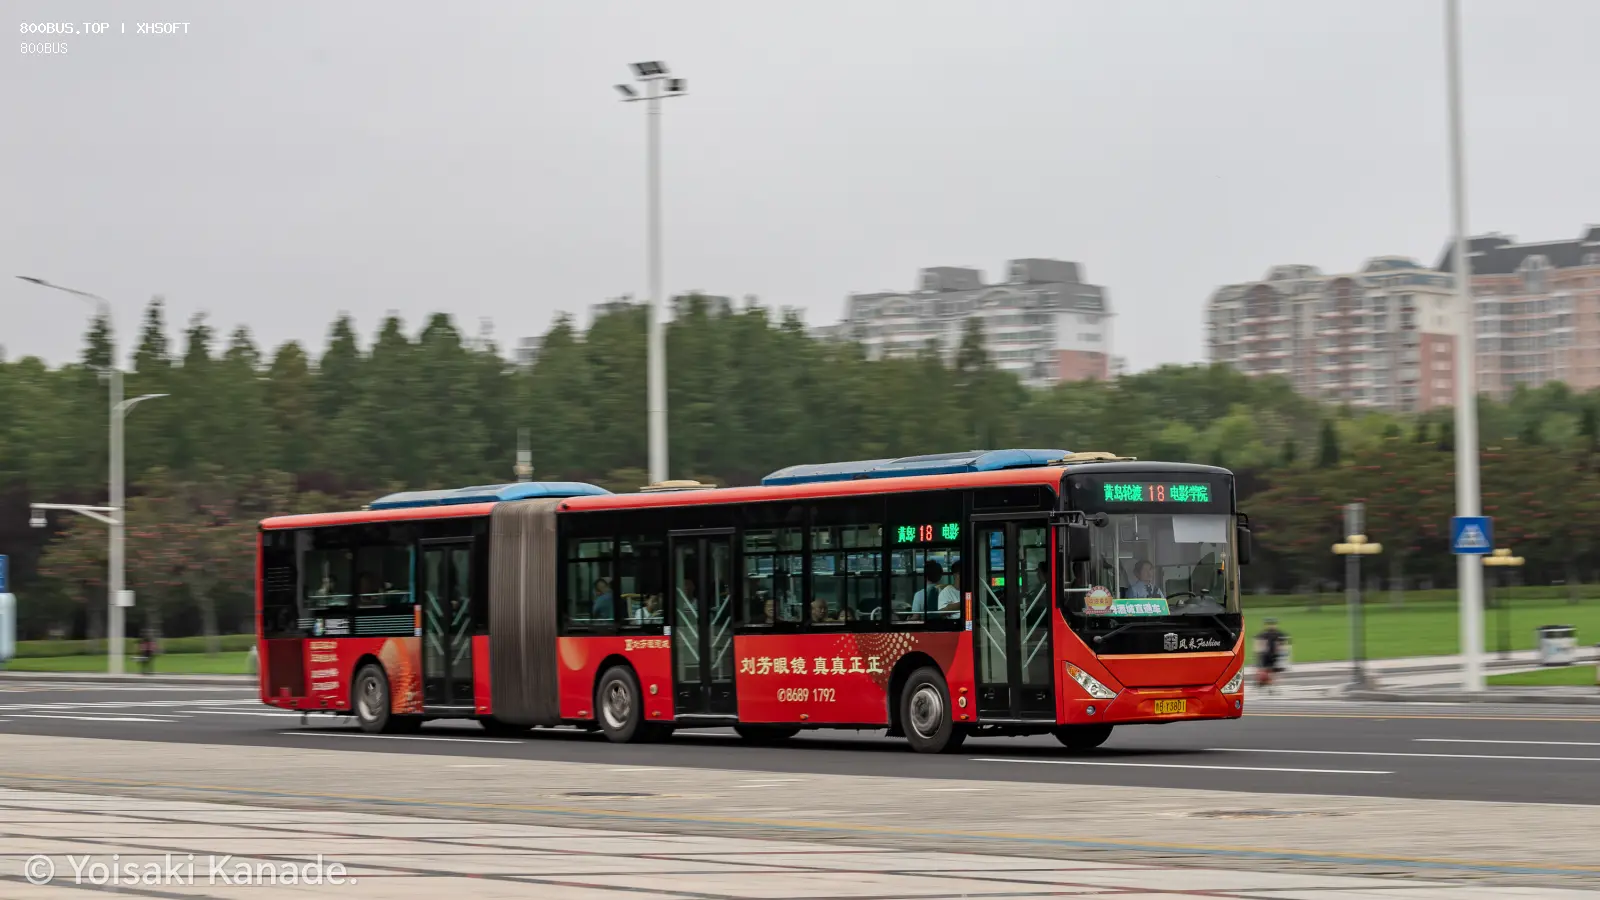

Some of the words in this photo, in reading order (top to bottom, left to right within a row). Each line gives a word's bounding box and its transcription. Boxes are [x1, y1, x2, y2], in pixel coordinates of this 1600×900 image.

[1103, 483, 1143, 501] 黄岛轮渡
[1148, 484, 1165, 502] 18
[1169, 484, 1208, 502] 电影学院
[919, 524, 933, 542] 18
[1196, 637, 1221, 649] Fashion
[740, 656, 808, 675] 刘芳眼镜
[813, 656, 884, 675] 真真正正
[786, 687, 810, 702] 8689
[812, 687, 837, 702] 1792
